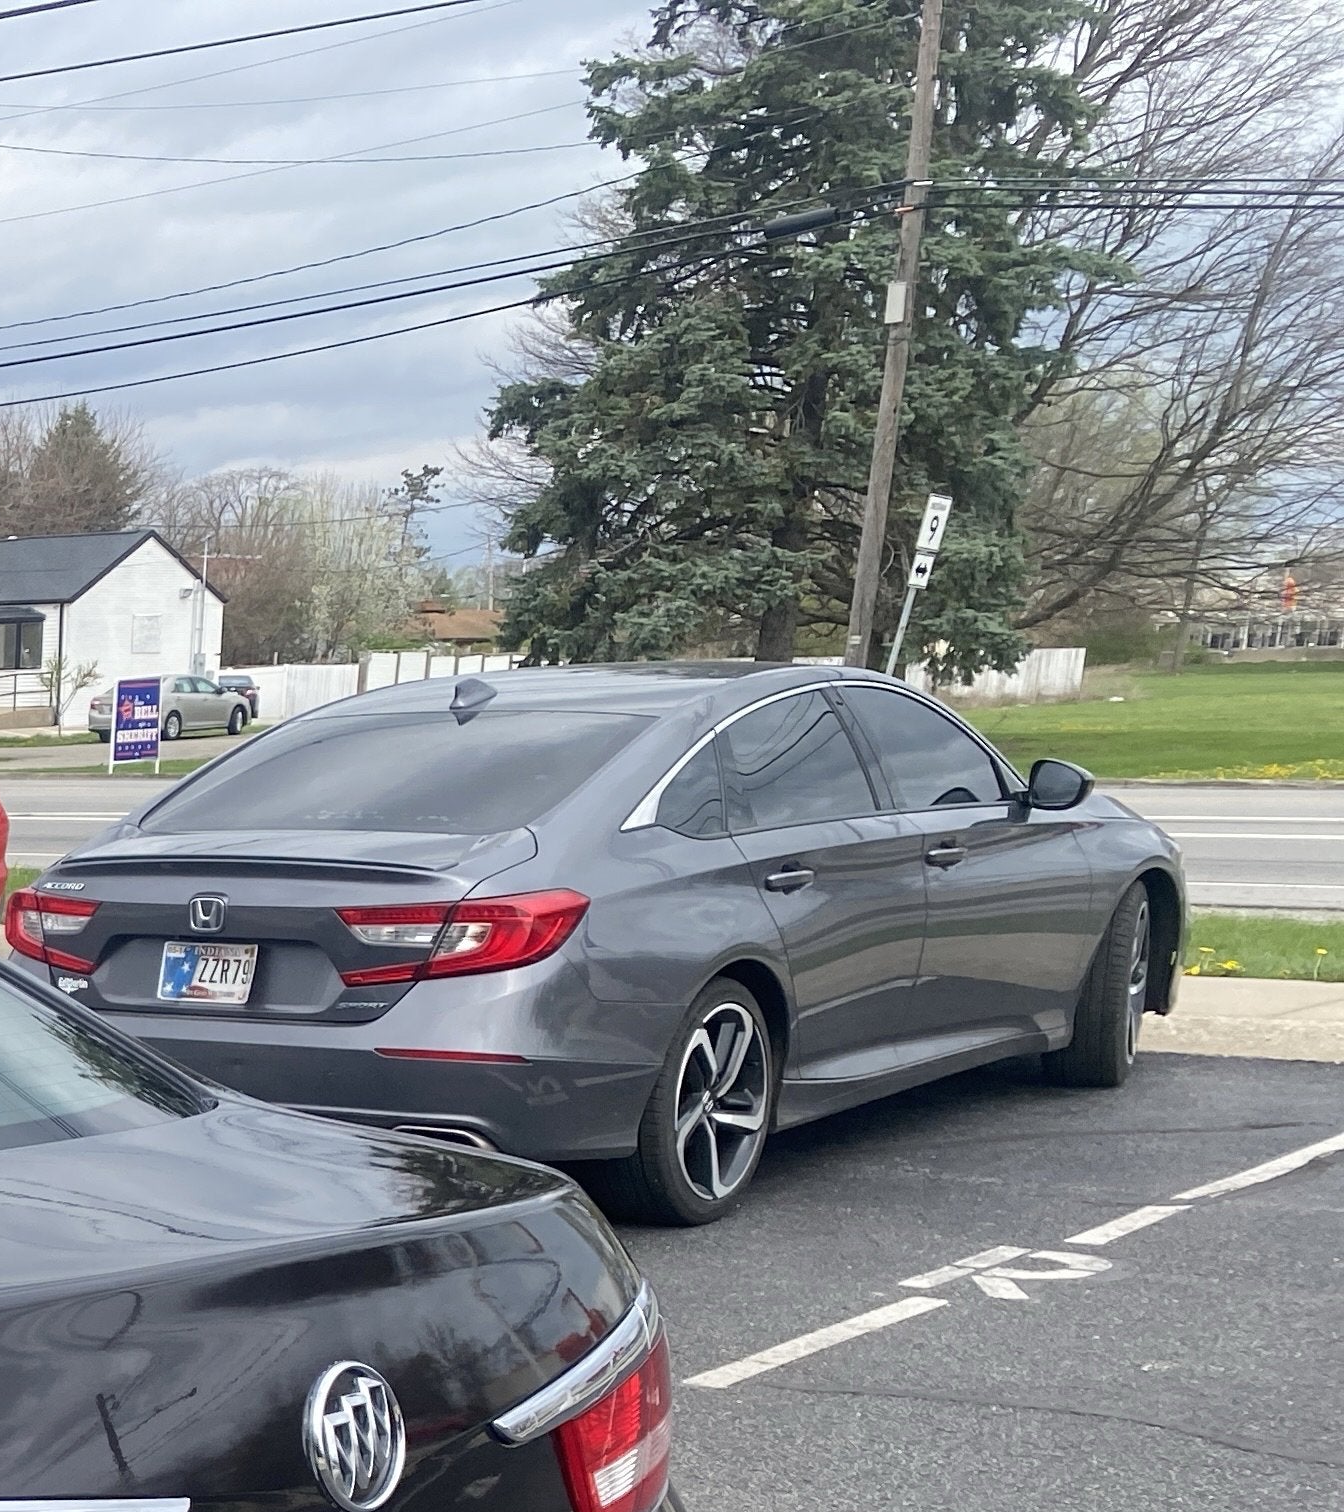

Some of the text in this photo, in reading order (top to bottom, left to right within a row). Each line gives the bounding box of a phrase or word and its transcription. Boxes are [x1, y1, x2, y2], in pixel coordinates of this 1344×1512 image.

[927, 515, 939, 545] 9
[134, 705, 159, 720] BELL
[116, 728, 159, 743] SHERIFF
[42, 881, 86, 891] ACCORD
